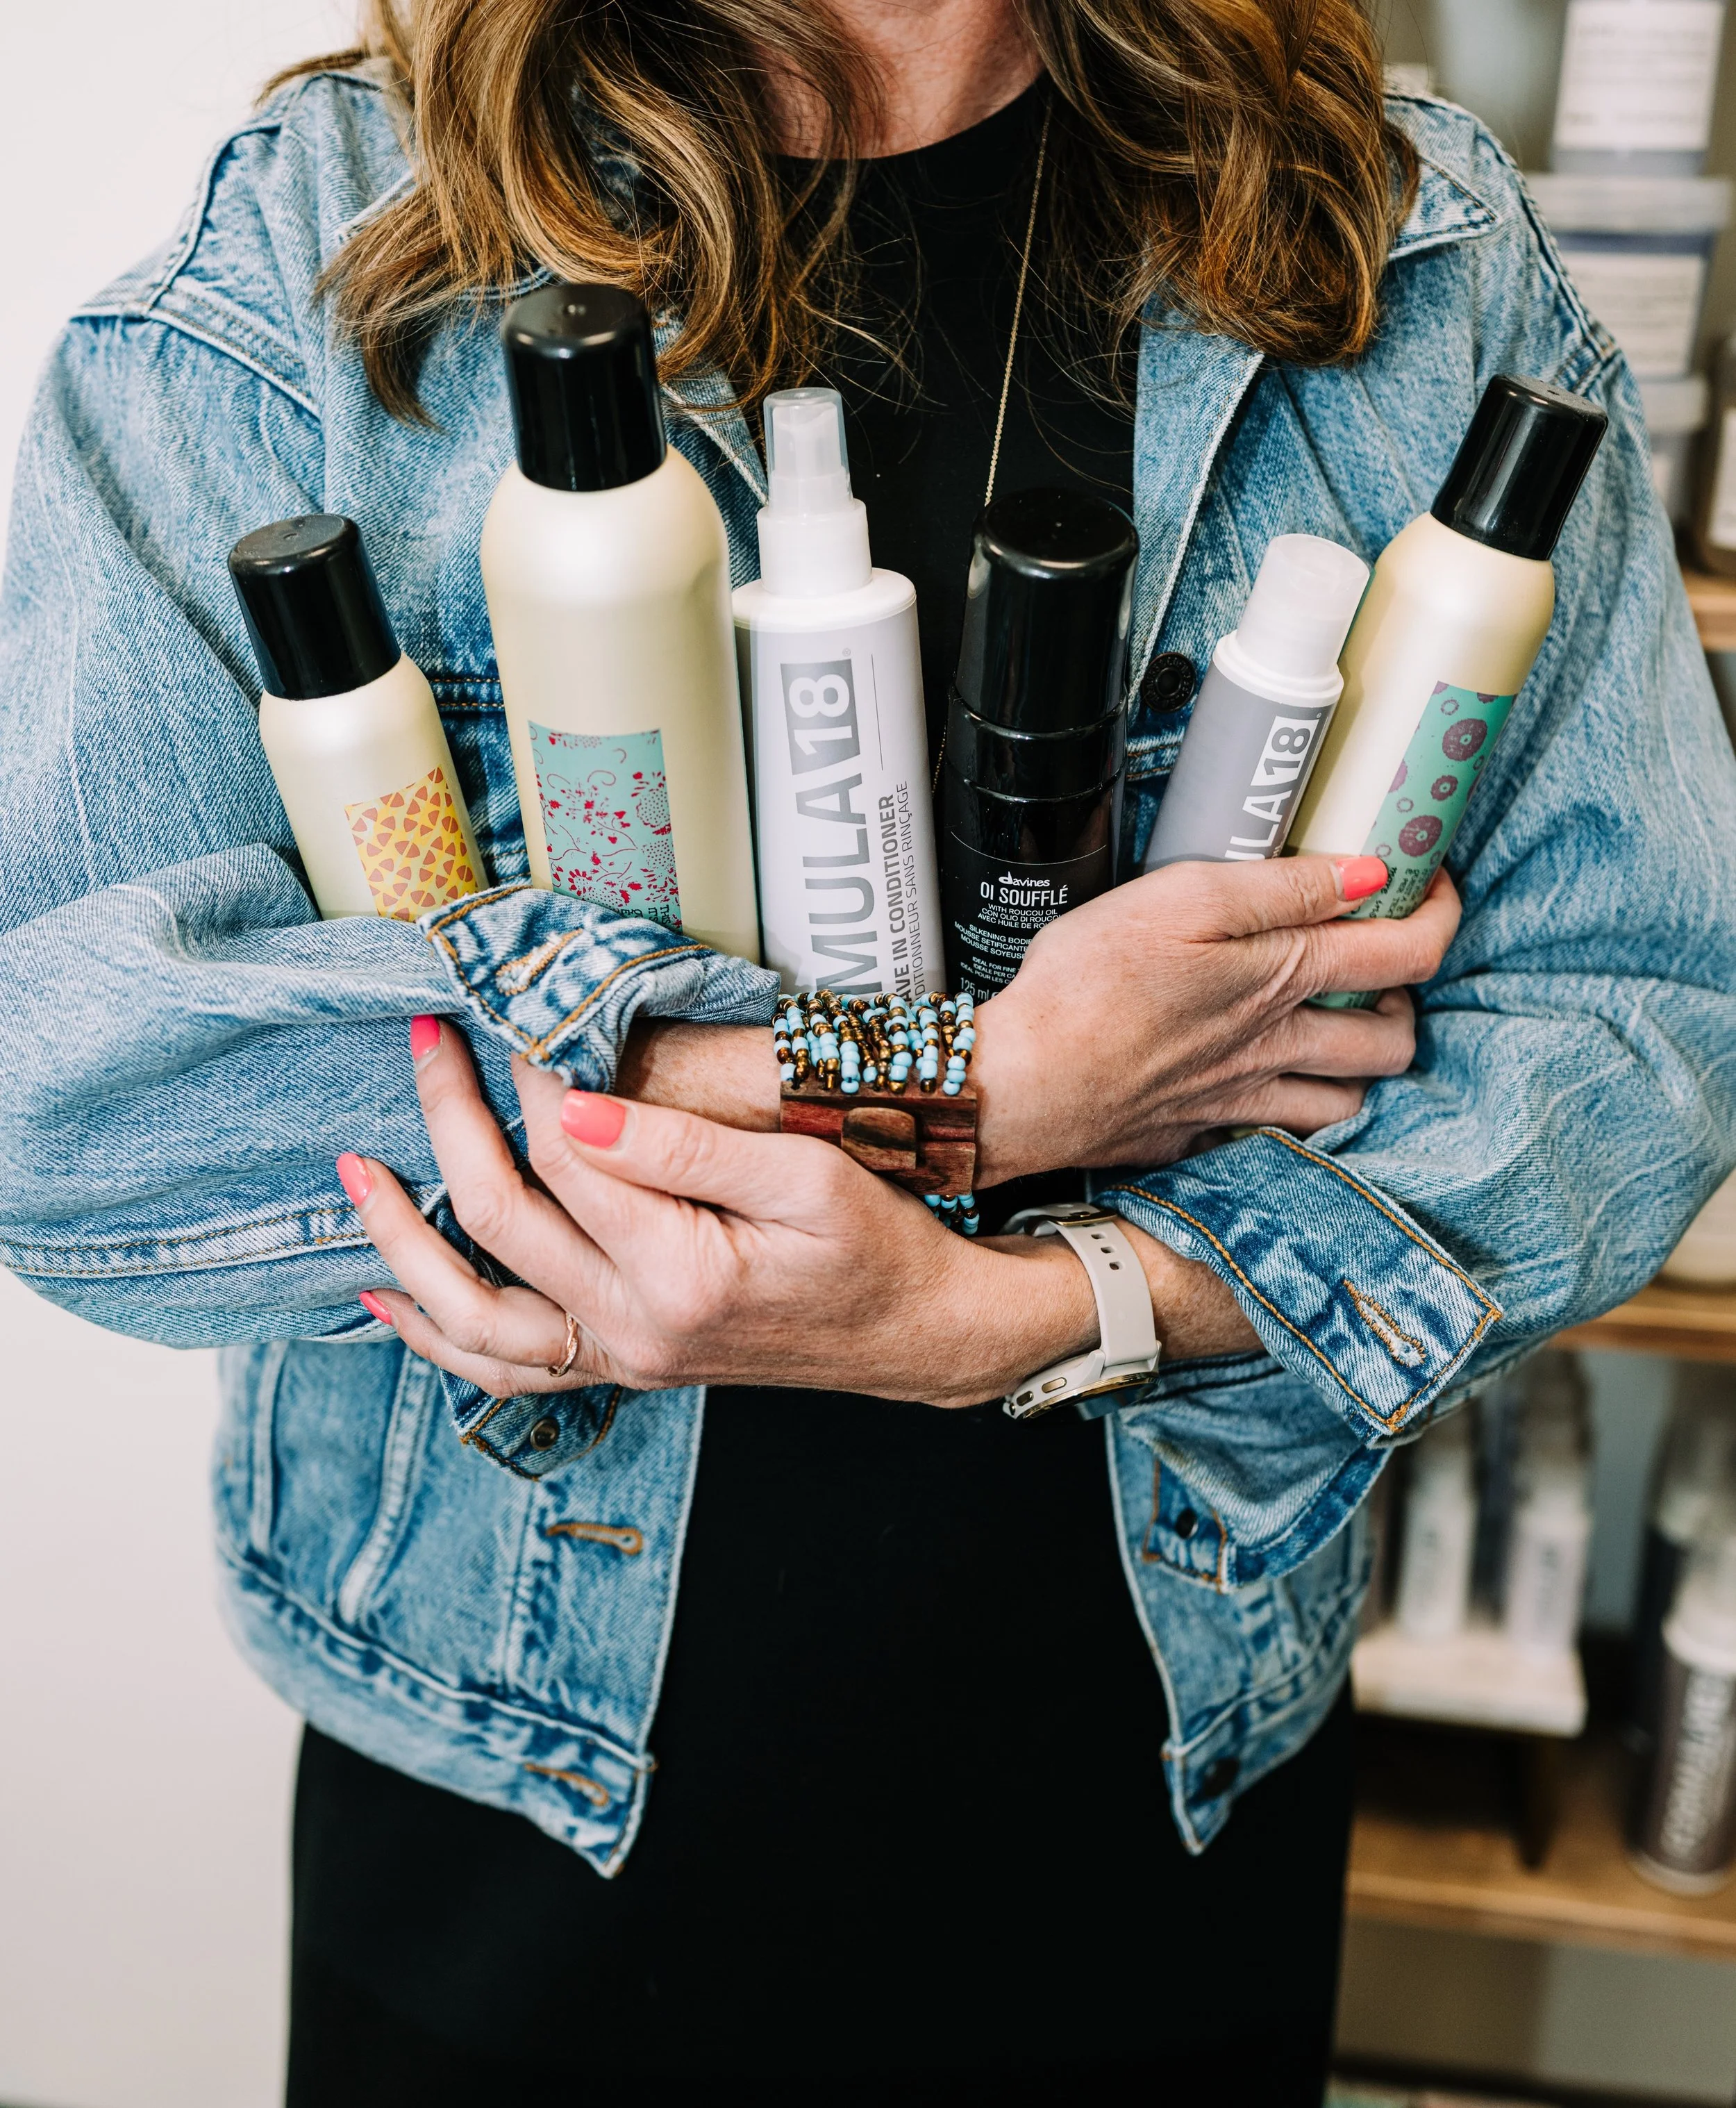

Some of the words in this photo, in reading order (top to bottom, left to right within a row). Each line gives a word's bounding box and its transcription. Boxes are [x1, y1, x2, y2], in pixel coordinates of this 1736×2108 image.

[896, 781, 913, 852] RINÇAGE
[878, 794, 905, 933] CONDITIONER
[903, 855, 917, 899] SANS
[999, 871, 1051, 887] davines
[980, 881, 994, 901] OI
[999, 884, 1069, 907] SOUFFLÉ
[981, 908, 999, 918] CON
[1000, 913, 1019, 922] OLIO
[987, 903, 1007, 913] WITH
[978, 913, 996, 924] AVEC
[998, 919, 1019, 929] HUILE
[955, 921, 980, 942] MOUSSE
[969, 924, 1006, 943] SILKENING
[892, 938, 908, 961] IN
[960, 933, 989, 952] MOUSSE
[989, 963, 1001, 971] FOR
[960, 977, 975, 996] 125
[978, 989, 990, 1001] ml
